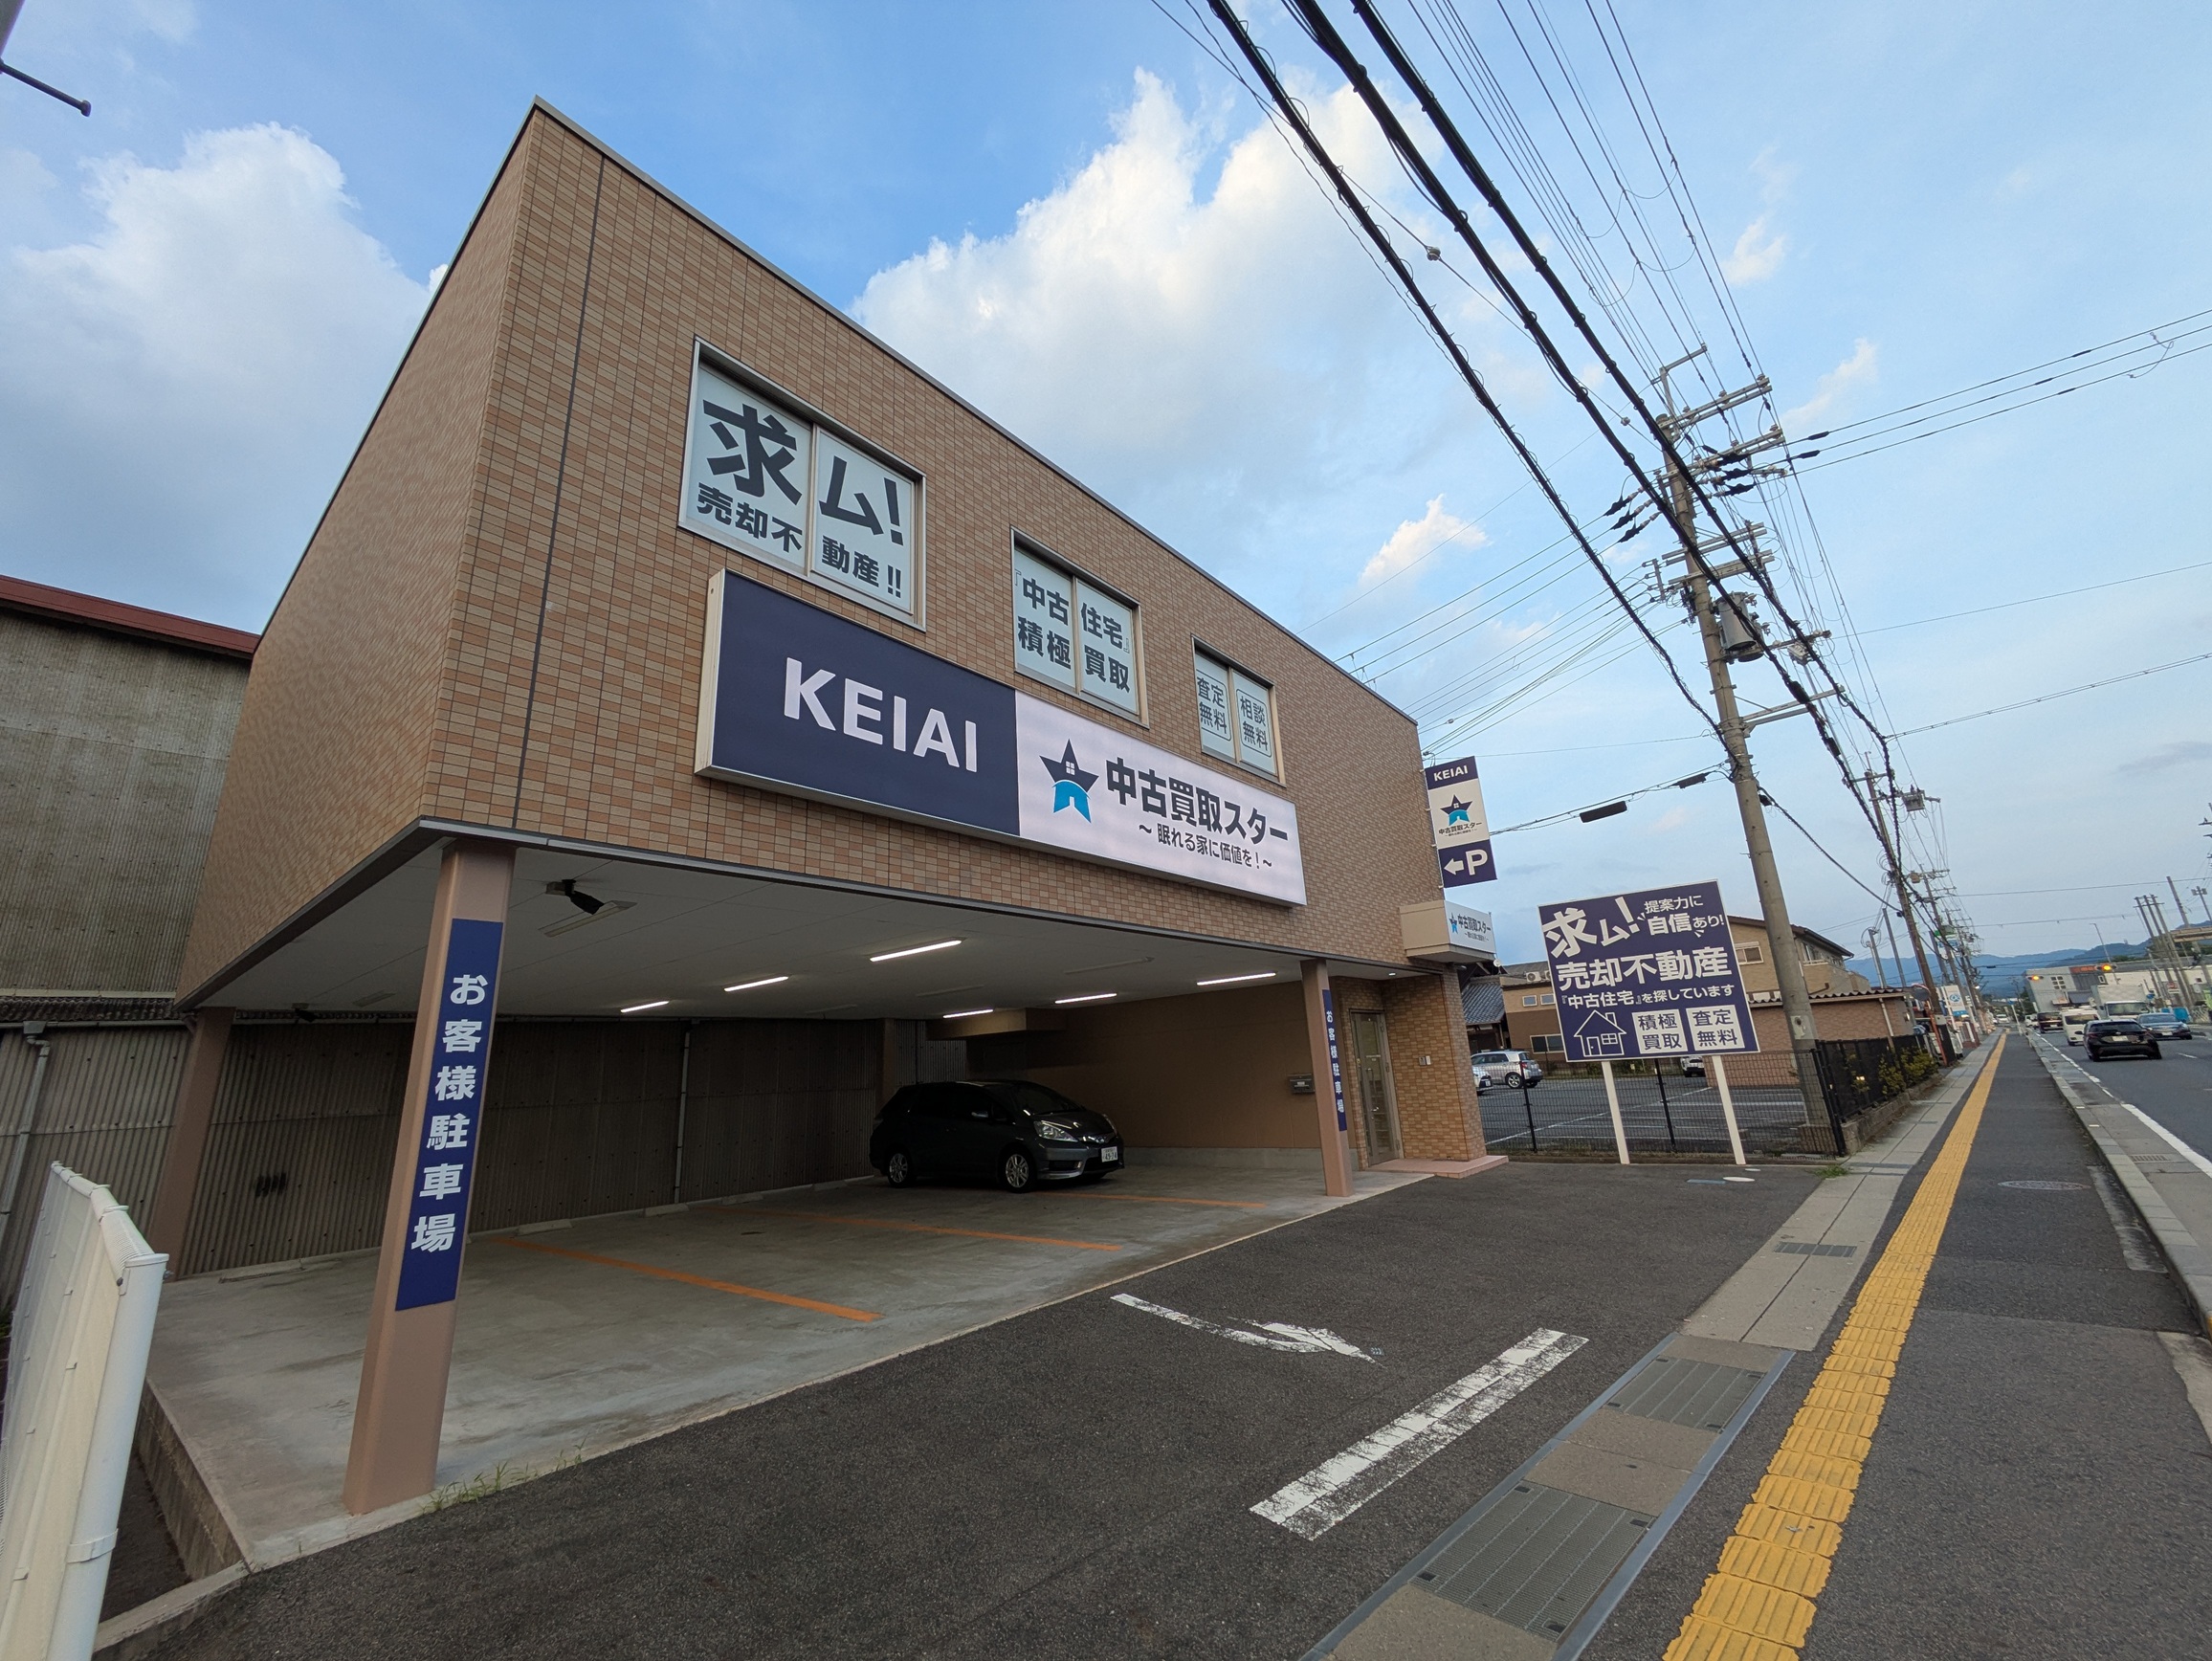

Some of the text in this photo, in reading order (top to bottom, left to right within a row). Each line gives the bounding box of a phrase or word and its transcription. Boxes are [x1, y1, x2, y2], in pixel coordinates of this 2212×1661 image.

[1197, 676, 1226, 710] 査定
[784, 656, 978, 773] KEIAI
[1199, 701, 1228, 735] 無料
[1240, 696, 1267, 727] 相談
[1243, 720, 1269, 752] 無料
[1433, 764, 1469, 782] KEIAI
[1106, 757, 1289, 845] 中古買取スター
[1465, 849, 1489, 876] P
[1644, 895, 1704, 914] 提案力に
[1541, 896, 1641, 959] 求ム!
[1556, 946, 1733, 991] 売却不動産
[1638, 1012, 1678, 1030] 積極
[1692, 1009, 1734, 1027] 査定
[1643, 1033, 1683, 1051] 買取
[1697, 1029, 1738, 1047] 無料
[410, 973, 489, 1253] お客様駐車場
